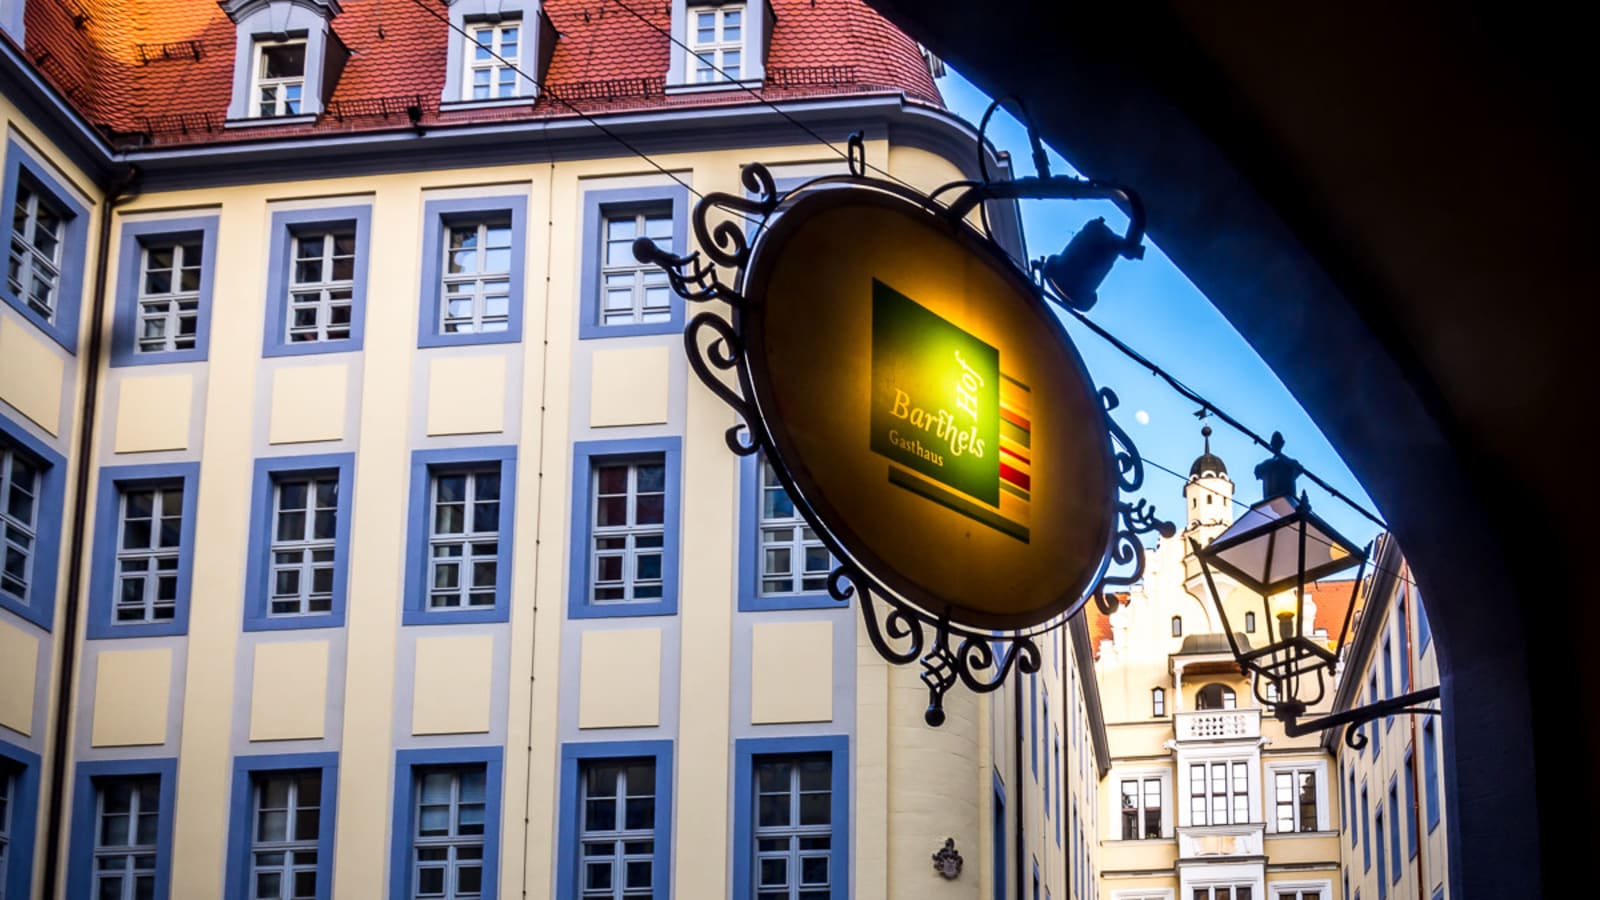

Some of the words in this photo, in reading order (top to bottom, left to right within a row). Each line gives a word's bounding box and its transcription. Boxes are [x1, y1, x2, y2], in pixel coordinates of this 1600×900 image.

[955, 350, 984, 422] Hof
[889, 388, 985, 458] Barthels
[889, 429, 944, 467] Gasthaus
